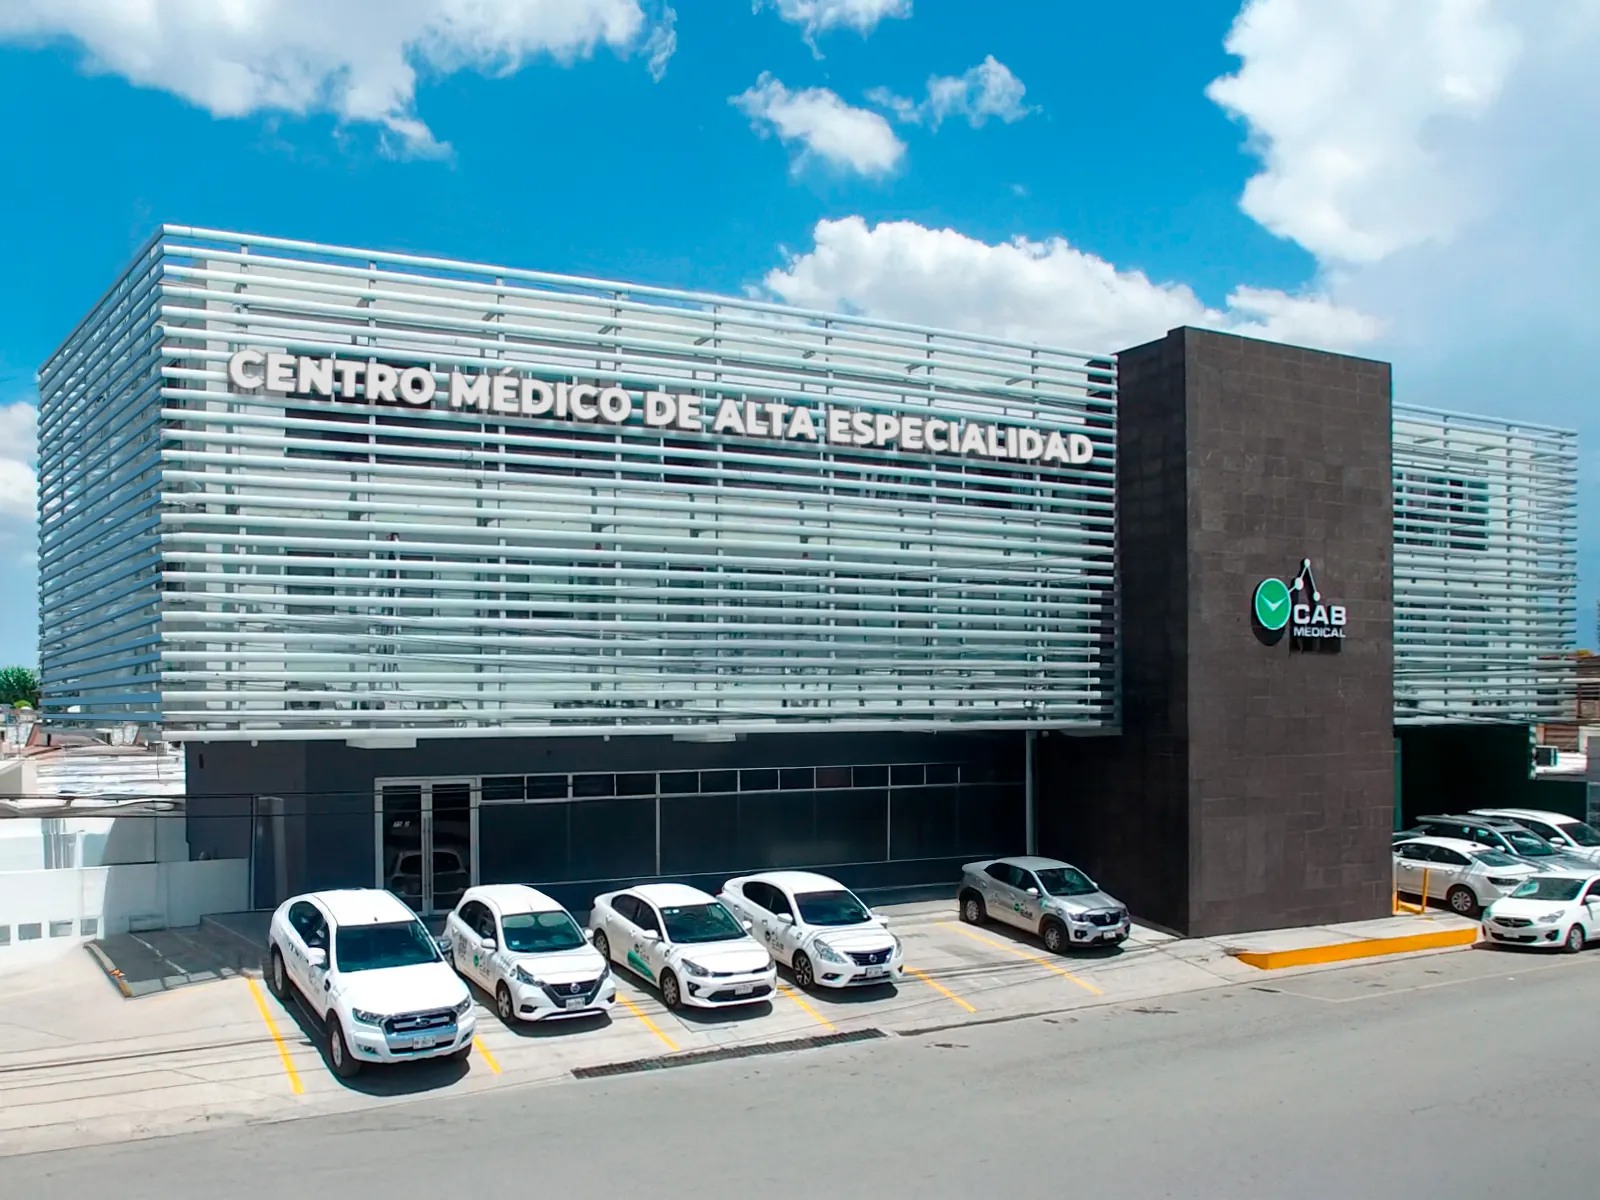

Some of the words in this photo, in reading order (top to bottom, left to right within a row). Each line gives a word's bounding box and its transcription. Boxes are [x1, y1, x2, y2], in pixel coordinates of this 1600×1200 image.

[228, 349, 437, 405] CENTRO
[450, 367, 632, 423] MÉDICO
[642, 391, 701, 429] DE
[712, 397, 817, 440] ALTA
[826, 409, 1094, 465] ESPECIALIDAD
[1294, 604, 1347, 625] CAB
[1294, 627, 1347, 638] MEDICAL
